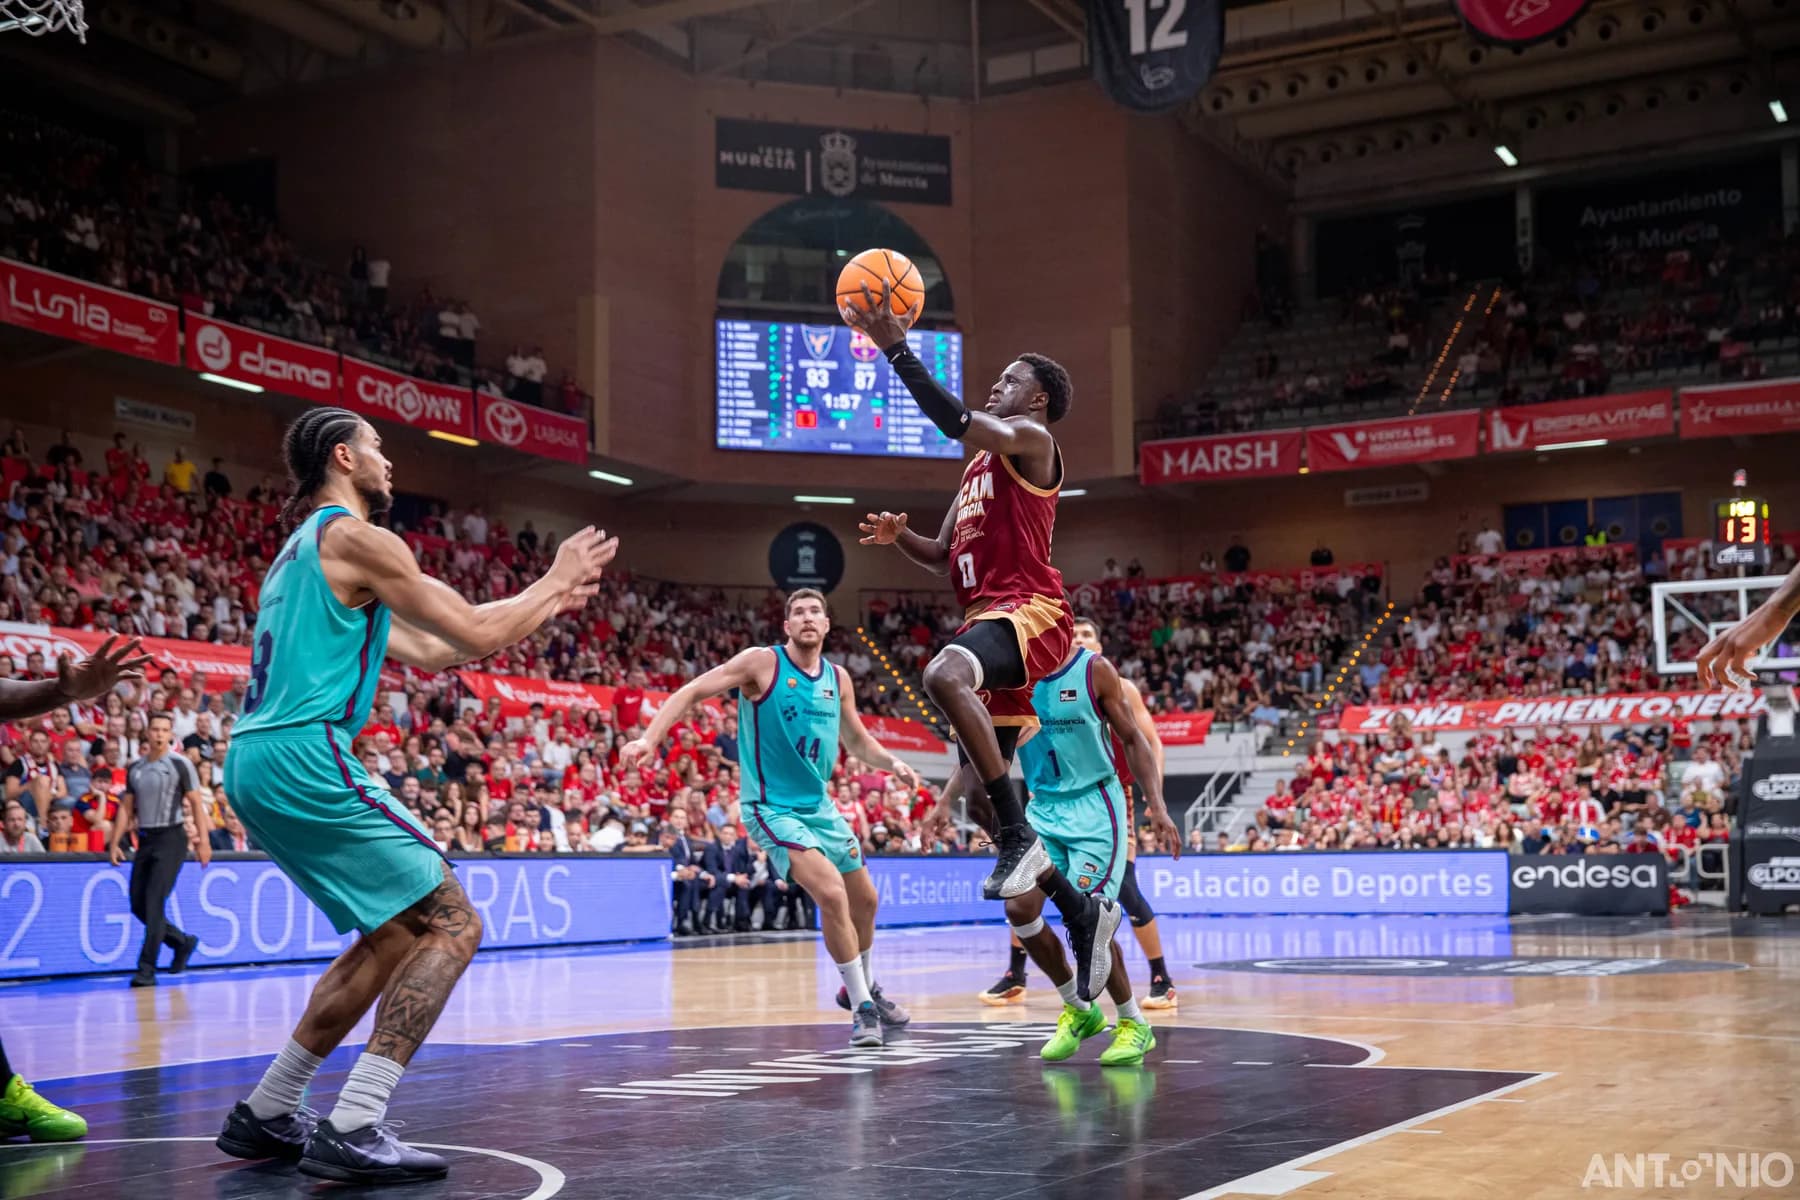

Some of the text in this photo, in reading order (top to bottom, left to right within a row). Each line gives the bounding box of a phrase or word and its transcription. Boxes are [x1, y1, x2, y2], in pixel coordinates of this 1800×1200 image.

[1124, 0, 1188, 54] 12
[1580, 188, 1743, 227] Ayuntamiento
[854, 369, 877, 390] 87
[356, 375, 463, 424] CROWN
[1163, 440, 1279, 476] MARSH
[958, 471, 995, 507] CAM
[1726, 516, 1756, 543] 13
[957, 552, 977, 589] 0
[1490, 690, 1768, 727] PIMENTONERA
[795, 735, 821, 764] 44
[1047, 749, 1061, 778] 1
[899, 869, 972, 905] Estación
[1153, 868, 1270, 898] Palacio
[1281, 867, 1321, 897] de
[1332, 867, 1493, 903] Deportes
[1512, 858, 1658, 889] endesa
[0, 870, 44, 969] 2
[80, 863, 573, 964] GSOLRAS
